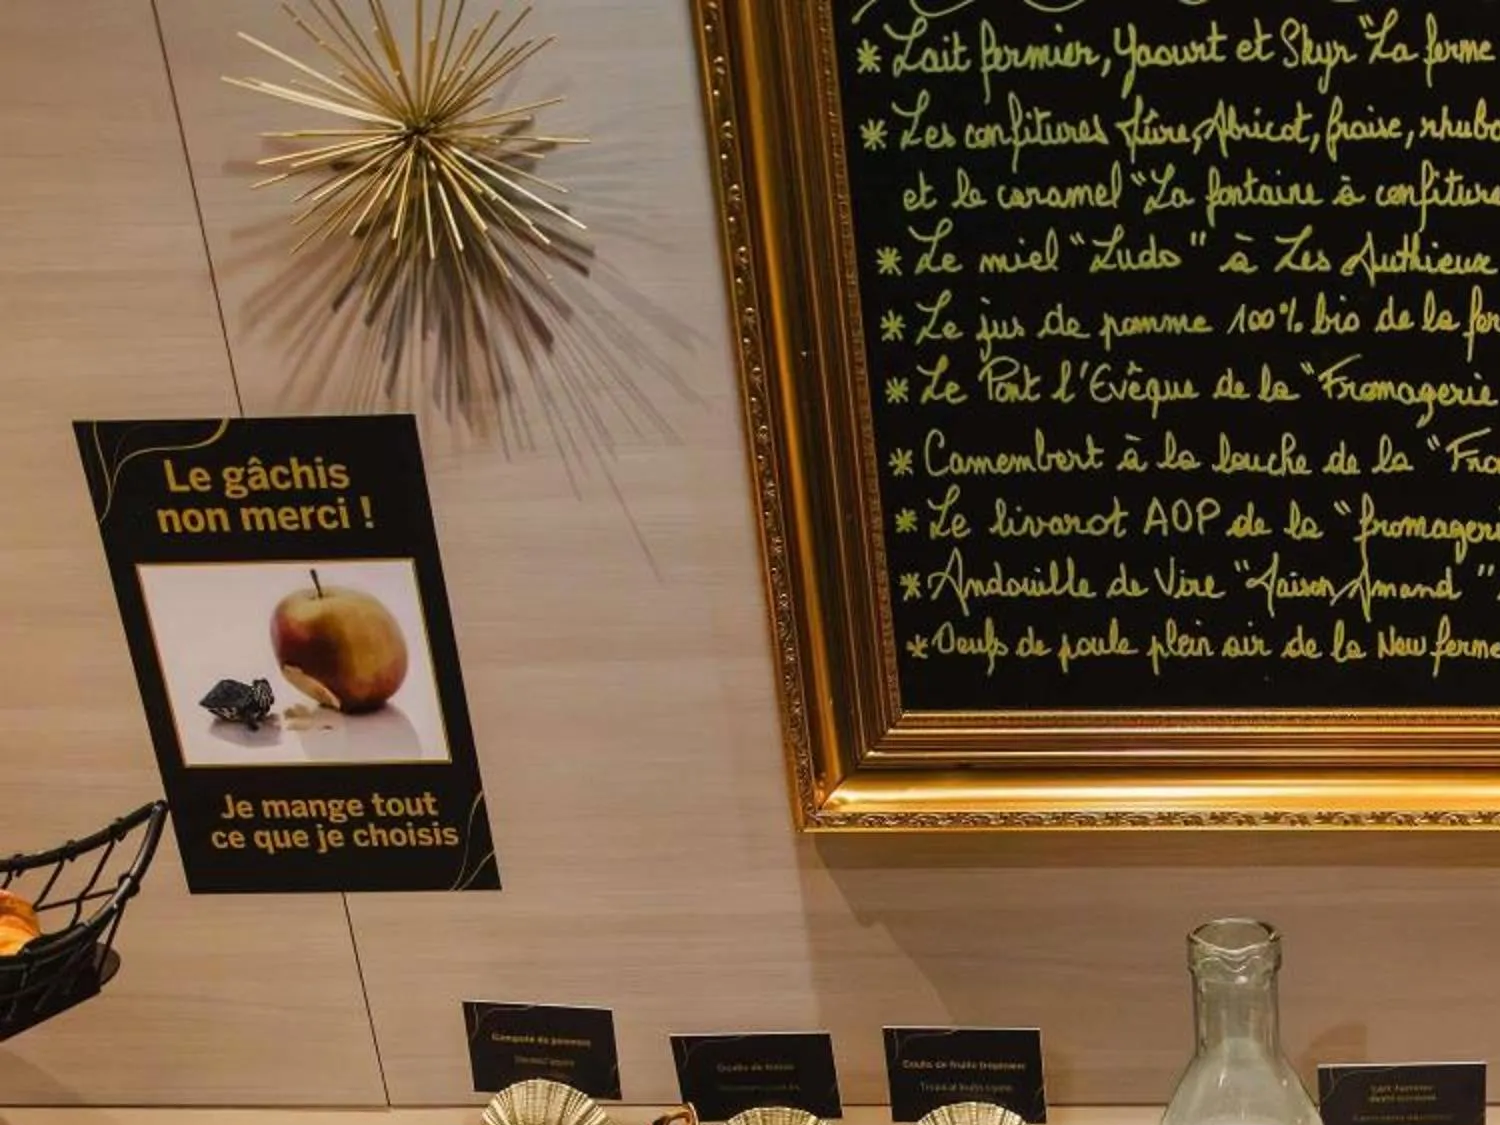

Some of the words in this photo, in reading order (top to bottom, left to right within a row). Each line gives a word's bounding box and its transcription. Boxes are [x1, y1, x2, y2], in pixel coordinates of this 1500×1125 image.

[885, 15, 970, 75] Lait
[981, 20, 1111, 103] fermier,
[1236, 18, 1274, 61] et
[1281, 18, 1357, 94] Skyr
[1424, 13, 1495, 87] ferme
[892, 90, 956, 149] Les
[965, 92, 1108, 172] confitures
[1326, 96, 1414, 162] fraise,
[904, 172, 936, 211] et
[952, 168, 986, 208] le
[998, 161, 1122, 209] caramel
[1206, 167, 1323, 227] fontaine
[1332, 176, 1365, 206] à
[909, 218, 962, 273] Le
[980, 229, 1058, 272] miel
[1220, 233, 1258, 273] à
[1275, 225, 1331, 272] Les
[916, 290, 963, 344] Le
[976, 297, 1024, 362] jus
[1038, 304, 1090, 338] de
[1100, 313, 1212, 350] pomme
[1311, 292, 1360, 334] bio
[1375, 296, 1414, 332] de
[1422, 290, 1460, 332] la
[917, 355, 967, 404] Le
[978, 356, 1040, 402] Pont
[1213, 368, 1250, 399] de
[1258, 364, 1299, 402] la
[163, 460, 211, 493] Le
[222, 456, 350, 498] gâchis
[925, 429, 1104, 476] Camembert
[1117, 434, 1147, 471] à
[1157, 431, 1200, 470] la
[1212, 433, 1312, 476] louche
[1323, 441, 1360, 474] de
[1372, 434, 1414, 473] la
[157, 507, 231, 534] non
[240, 496, 350, 531] merci
[362, 496, 376, 529] !
[928, 485, 970, 538] Le
[990, 497, 1128, 537] livarot
[1144, 497, 1220, 536] AOP
[1226, 502, 1272, 537] de
[1284, 500, 1323, 540] la
[928, 548, 1096, 616] Andouille
[1107, 564, 1148, 597] de
[1154, 557, 1225, 598] Vire
[1016, 627, 1051, 656] de
[1058, 618, 1138, 672] poule
[1222, 622, 1271, 657] air
[1281, 626, 1322, 658] de
[1331, 620, 1366, 662] la
[221, 794, 254, 820] Je
[262, 797, 365, 823] mange
[372, 791, 438, 817] tout
[211, 828, 245, 850] ce
[254, 828, 309, 854] que
[317, 825, 344, 854] je
[353, 822, 459, 848] choisis
